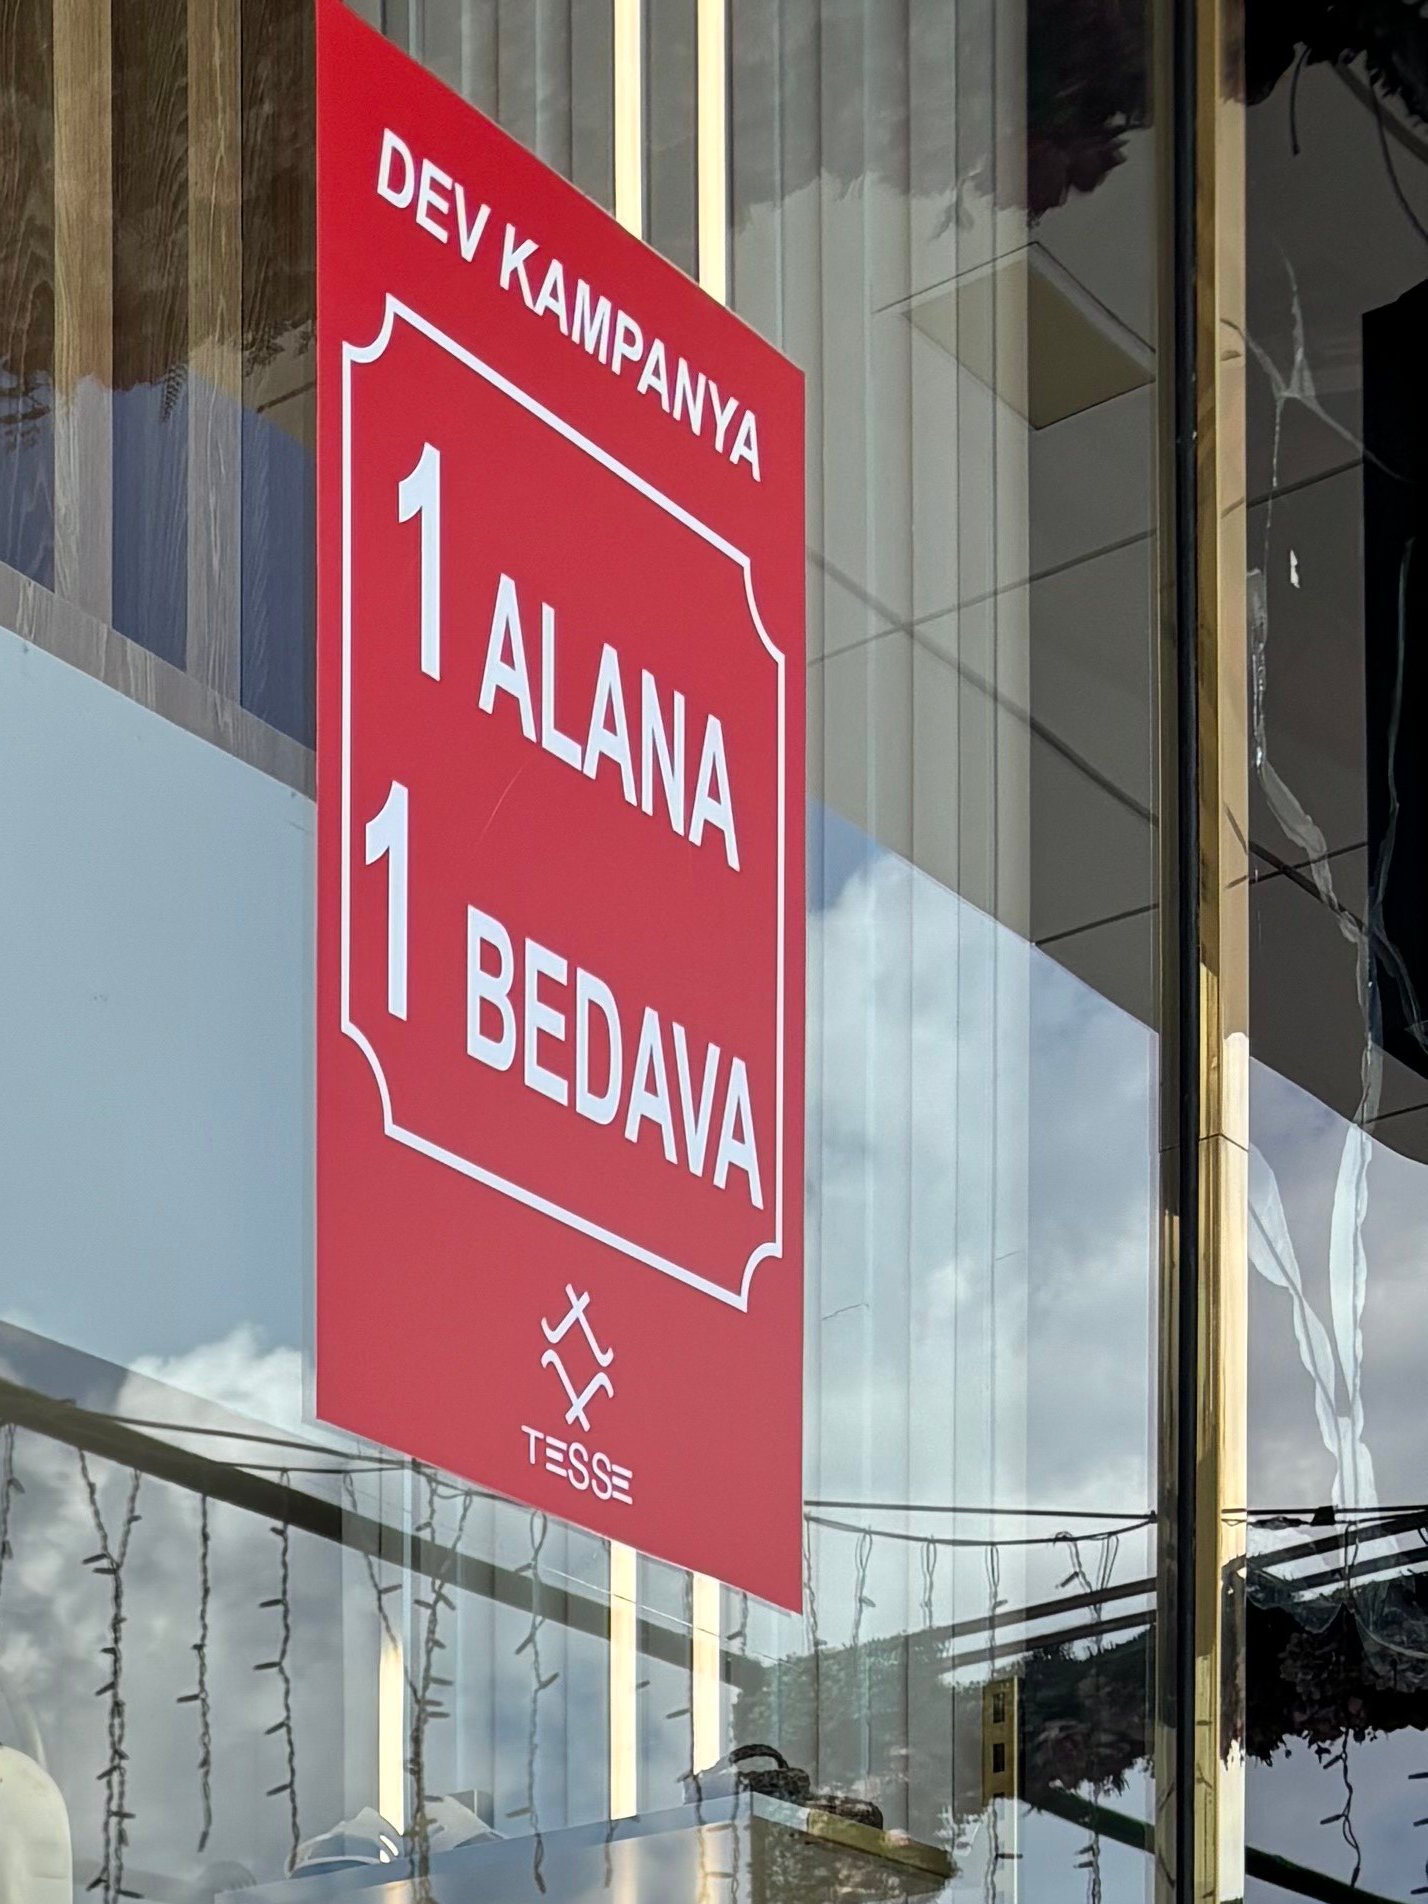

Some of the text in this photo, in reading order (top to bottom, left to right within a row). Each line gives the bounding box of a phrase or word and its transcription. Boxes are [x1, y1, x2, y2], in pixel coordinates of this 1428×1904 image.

[376, 128, 761, 482] DEV KAMPANYA
[398, 441, 742, 872] 1 ALANA
[365, 780, 764, 1210] 1 BEDAVA
[521, 1424, 634, 1505] TESSE
